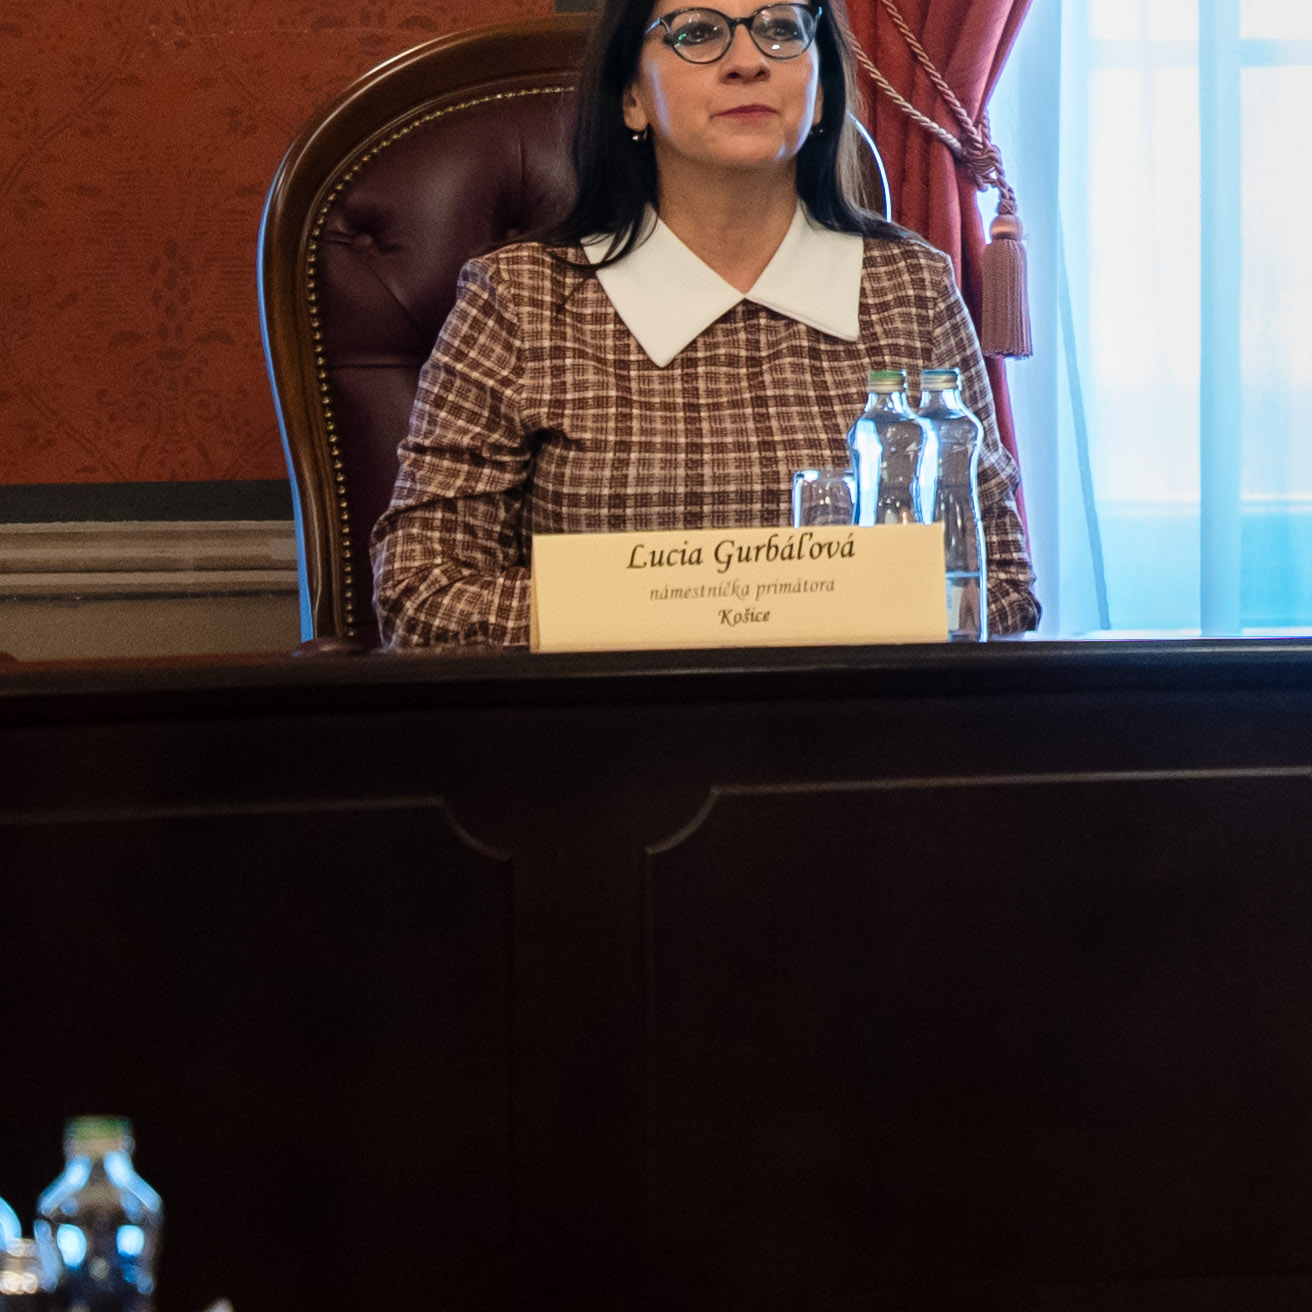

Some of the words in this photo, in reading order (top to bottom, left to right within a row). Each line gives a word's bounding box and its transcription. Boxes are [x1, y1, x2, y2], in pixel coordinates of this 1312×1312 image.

[625, 539, 703, 570] Lucia
[713, 531, 856, 574] Gurbáľová
[755, 578, 836, 602] primátora
[718, 607, 771, 627] Košice
